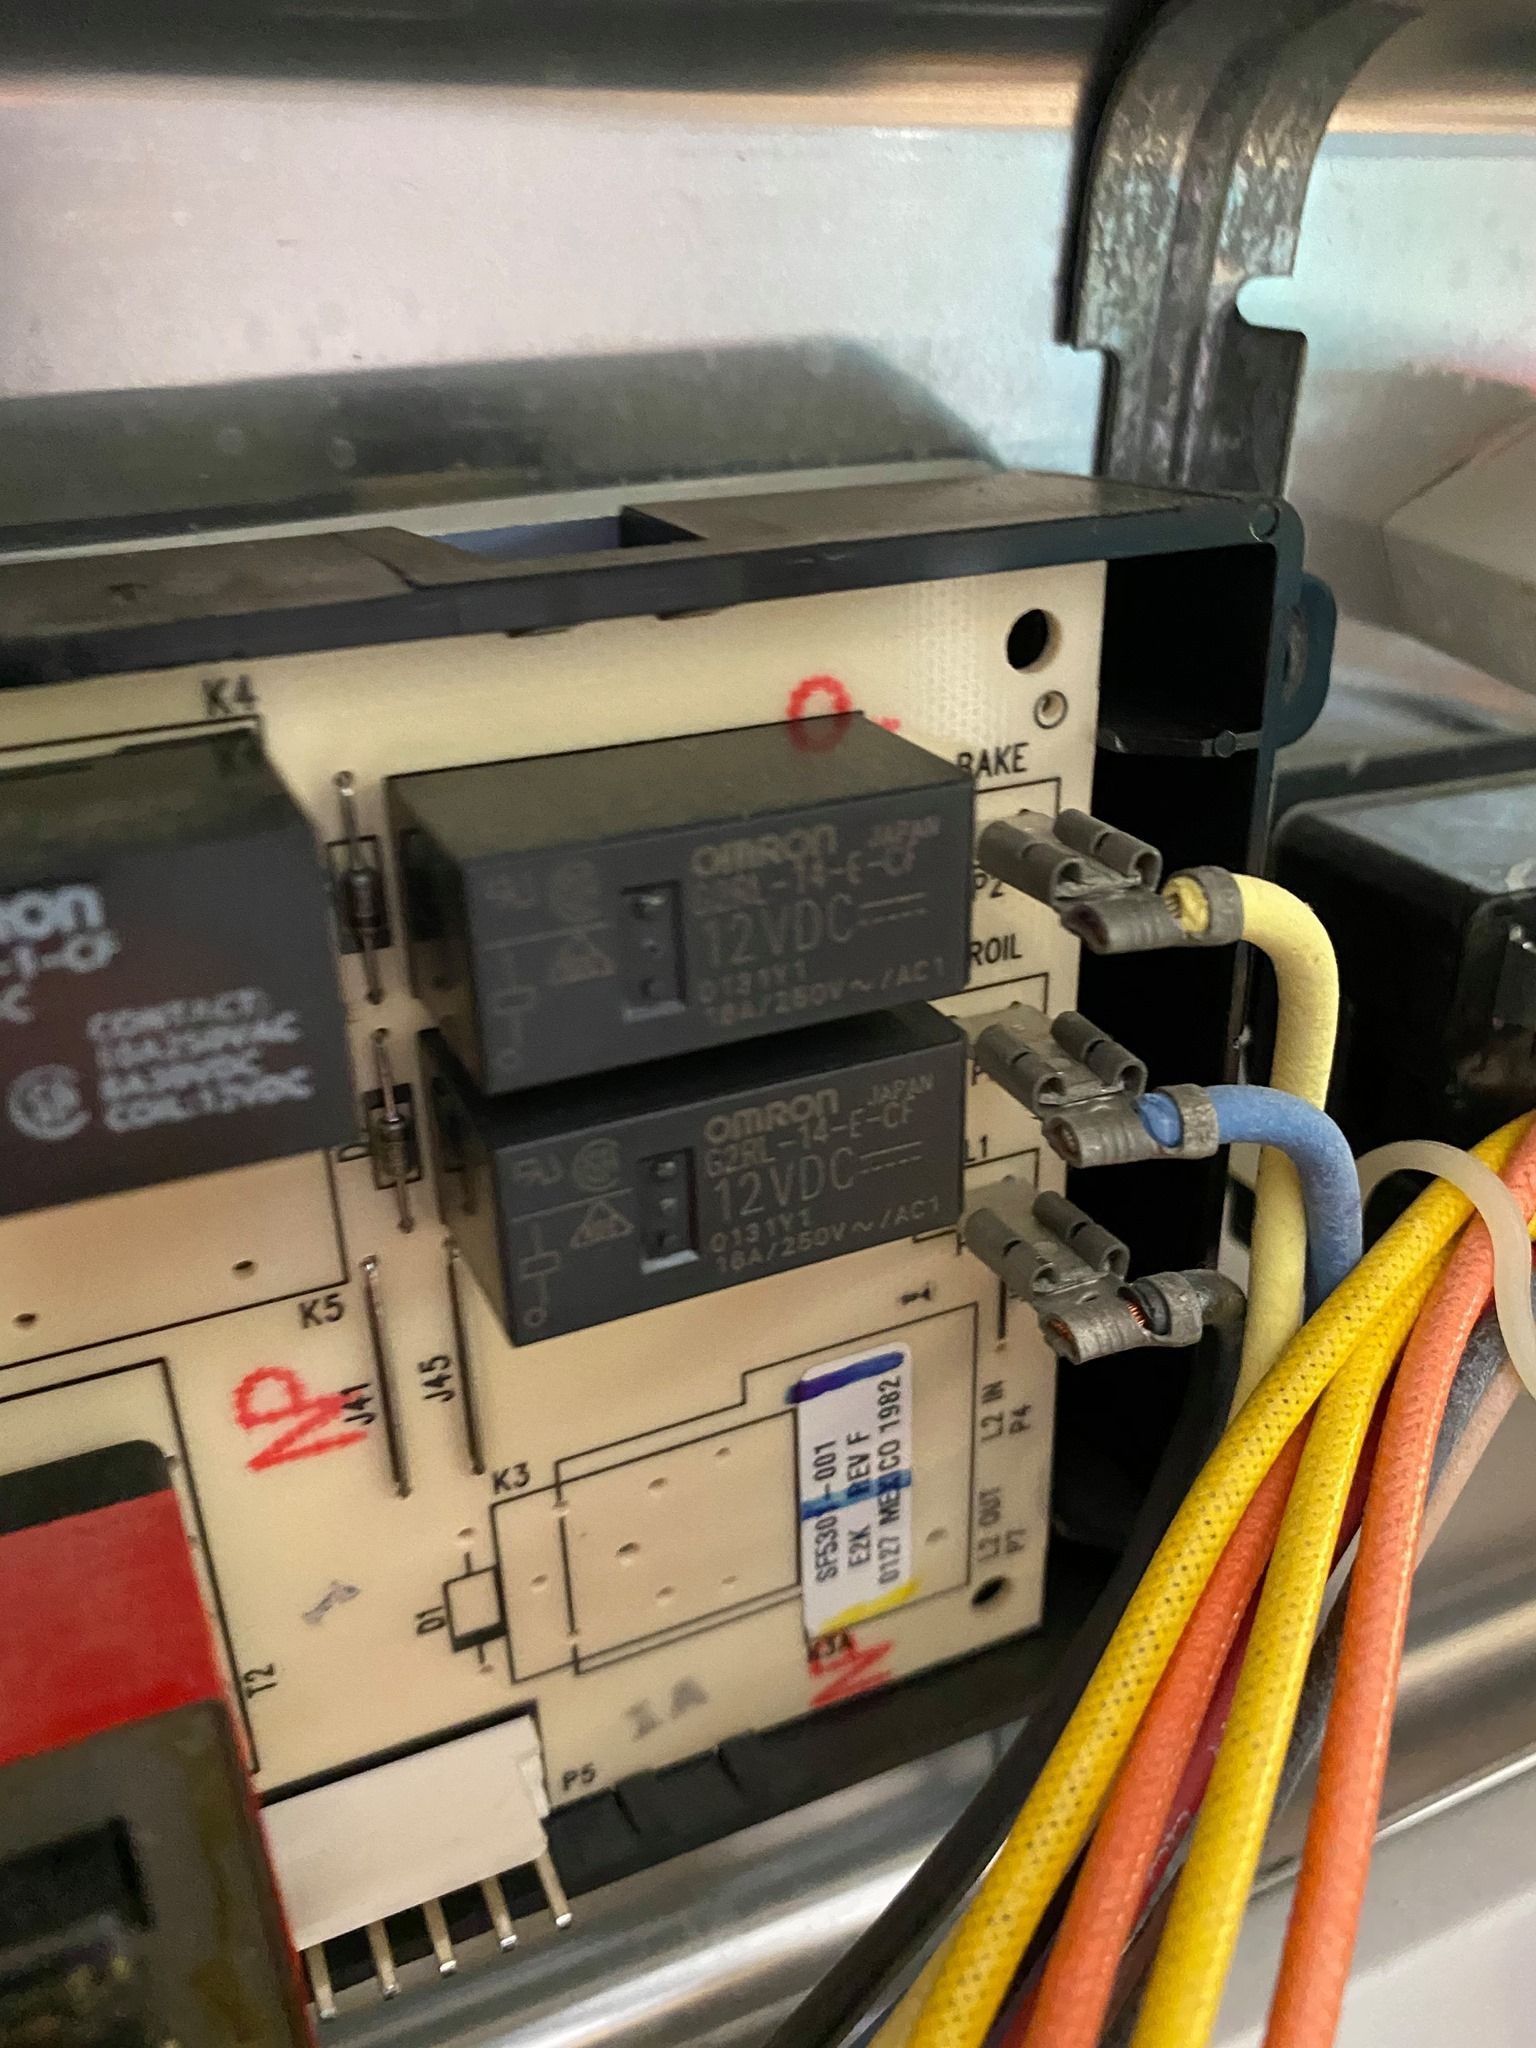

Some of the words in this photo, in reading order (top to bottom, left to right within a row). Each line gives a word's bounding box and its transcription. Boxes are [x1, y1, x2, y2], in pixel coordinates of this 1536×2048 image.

[201, 675, 258, 717] K4
[956, 742, 1029, 778] BAKE
[703, 890, 856, 968] 12VDC
[868, 1073, 936, 1107] JAPAN
[705, 1099, 916, 1177] G2RL-14-E-CF
[713, 1145, 856, 1222] 12VDC
[300, 1294, 344, 1329] K5
[417, 1355, 455, 1402] J45
[340, 1383, 377, 1425] J41
[878, 1378, 901, 1435] 1982
[847, 1430, 872, 1447] F
[981, 1413, 1004, 1441] L2
[492, 1462, 530, 1495] K3
[847, 1454, 872, 1498] REV
[848, 1526, 872, 1568] E2K
[878, 1533, 900, 1585] 0127
[416, 1607, 444, 1635] D1
[244, 1663, 277, 1699] T2
[563, 1763, 596, 1792] P5
